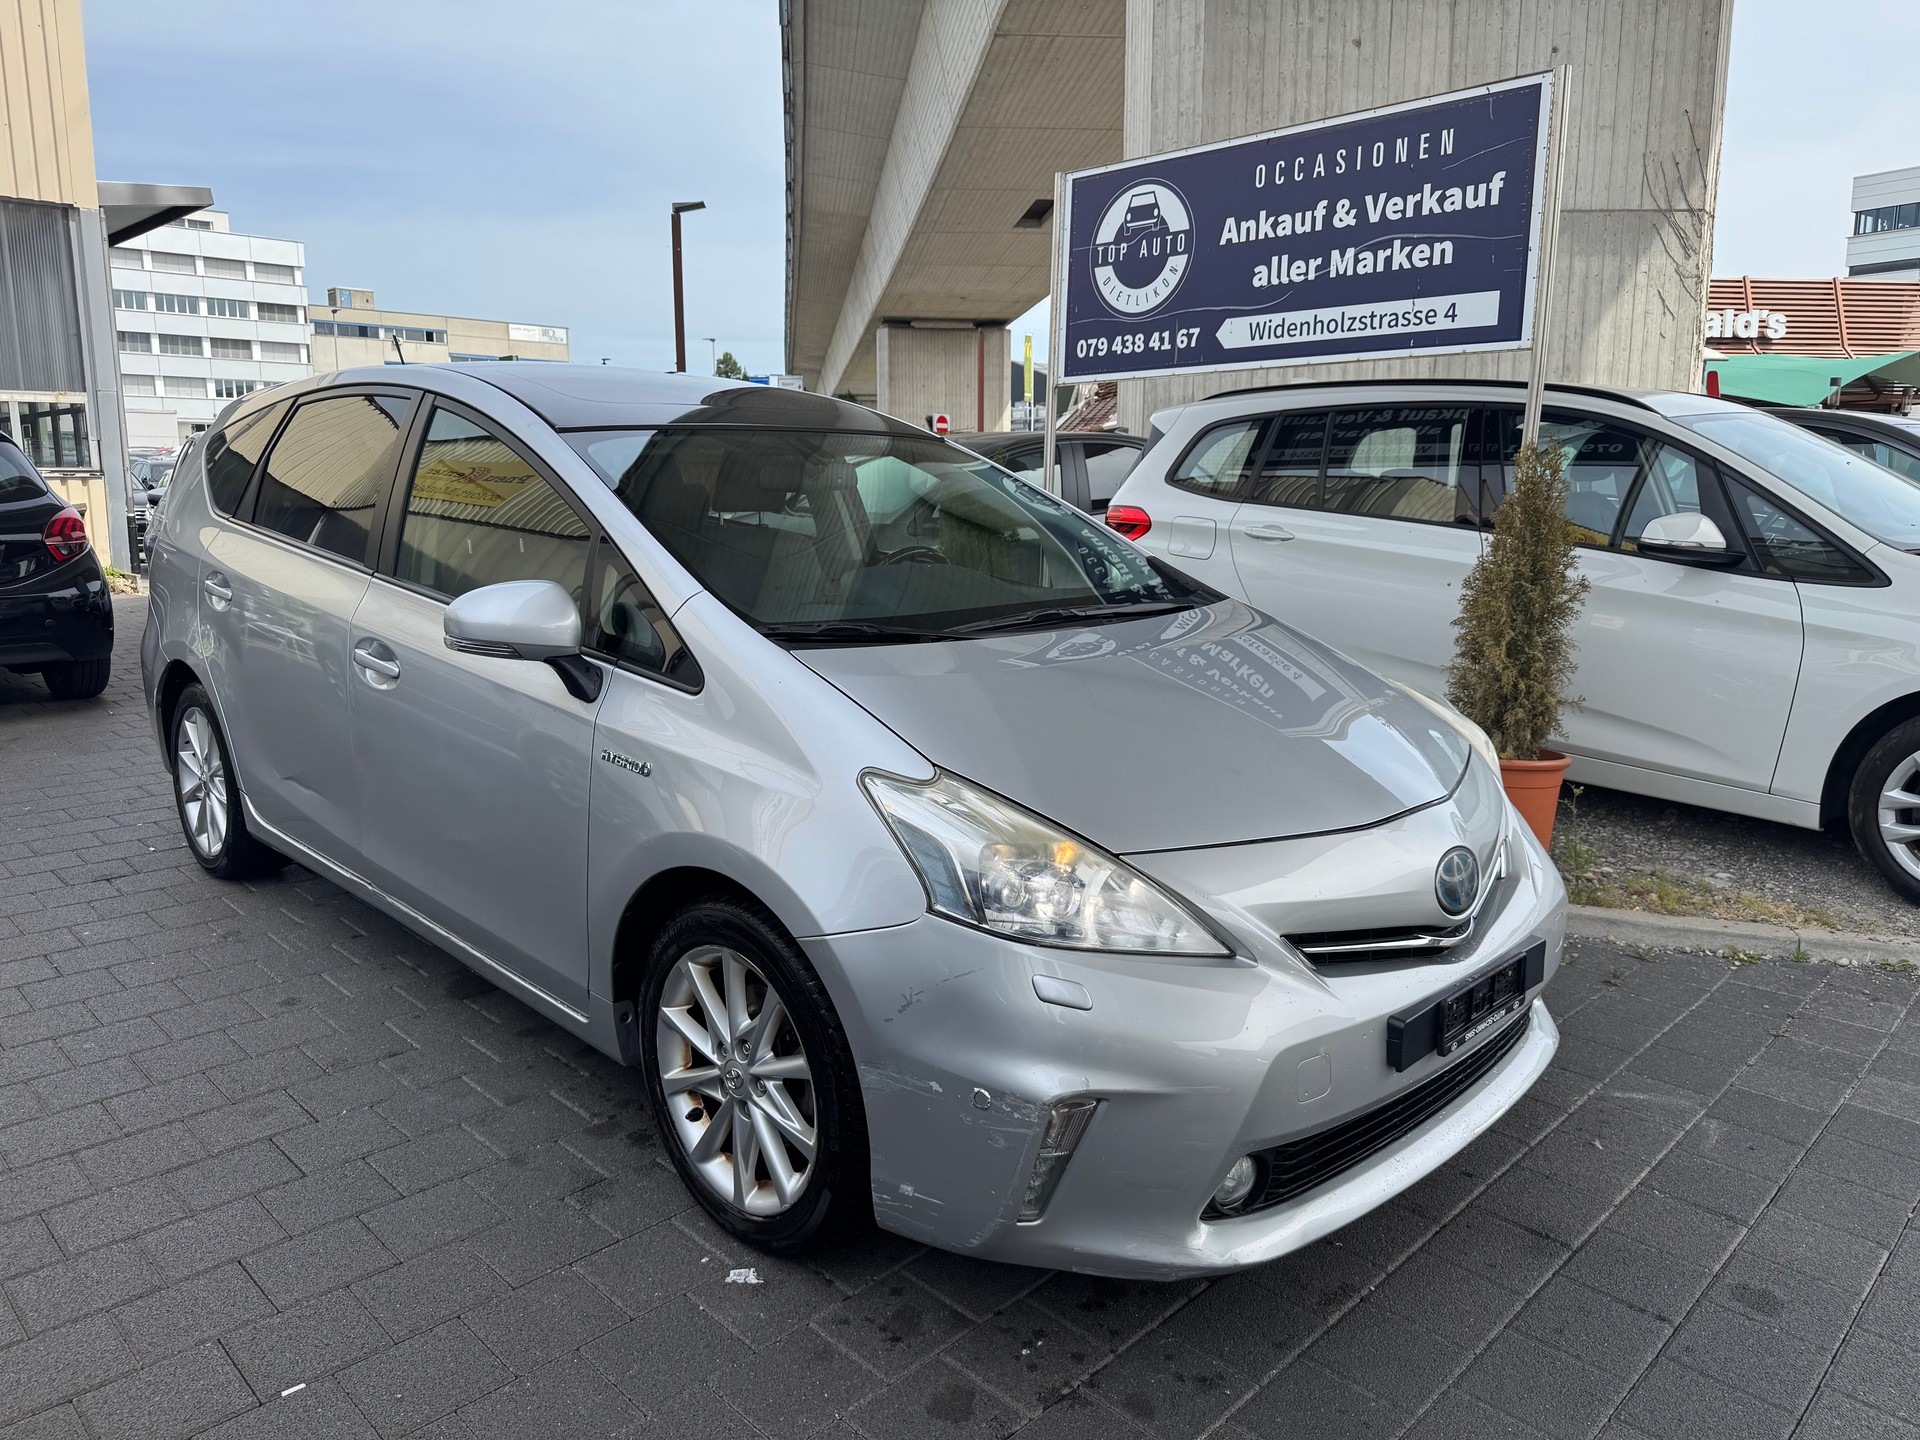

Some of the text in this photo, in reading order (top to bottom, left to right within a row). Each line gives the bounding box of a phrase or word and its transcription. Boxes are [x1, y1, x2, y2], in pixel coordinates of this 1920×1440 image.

[1255, 128, 1455, 188] OCCASIONEN
[1219, 170, 1506, 245] Ankauf & Verkauf
[1097, 233, 1185, 265] TOP AUTO
[1252, 239, 1454, 288] aller Marken
[1102, 264, 1179, 307] DIETLIKON
[1076, 327, 1201, 359] 079 438 41 67
[1248, 302, 1458, 342] Widenholzstrasse 4
